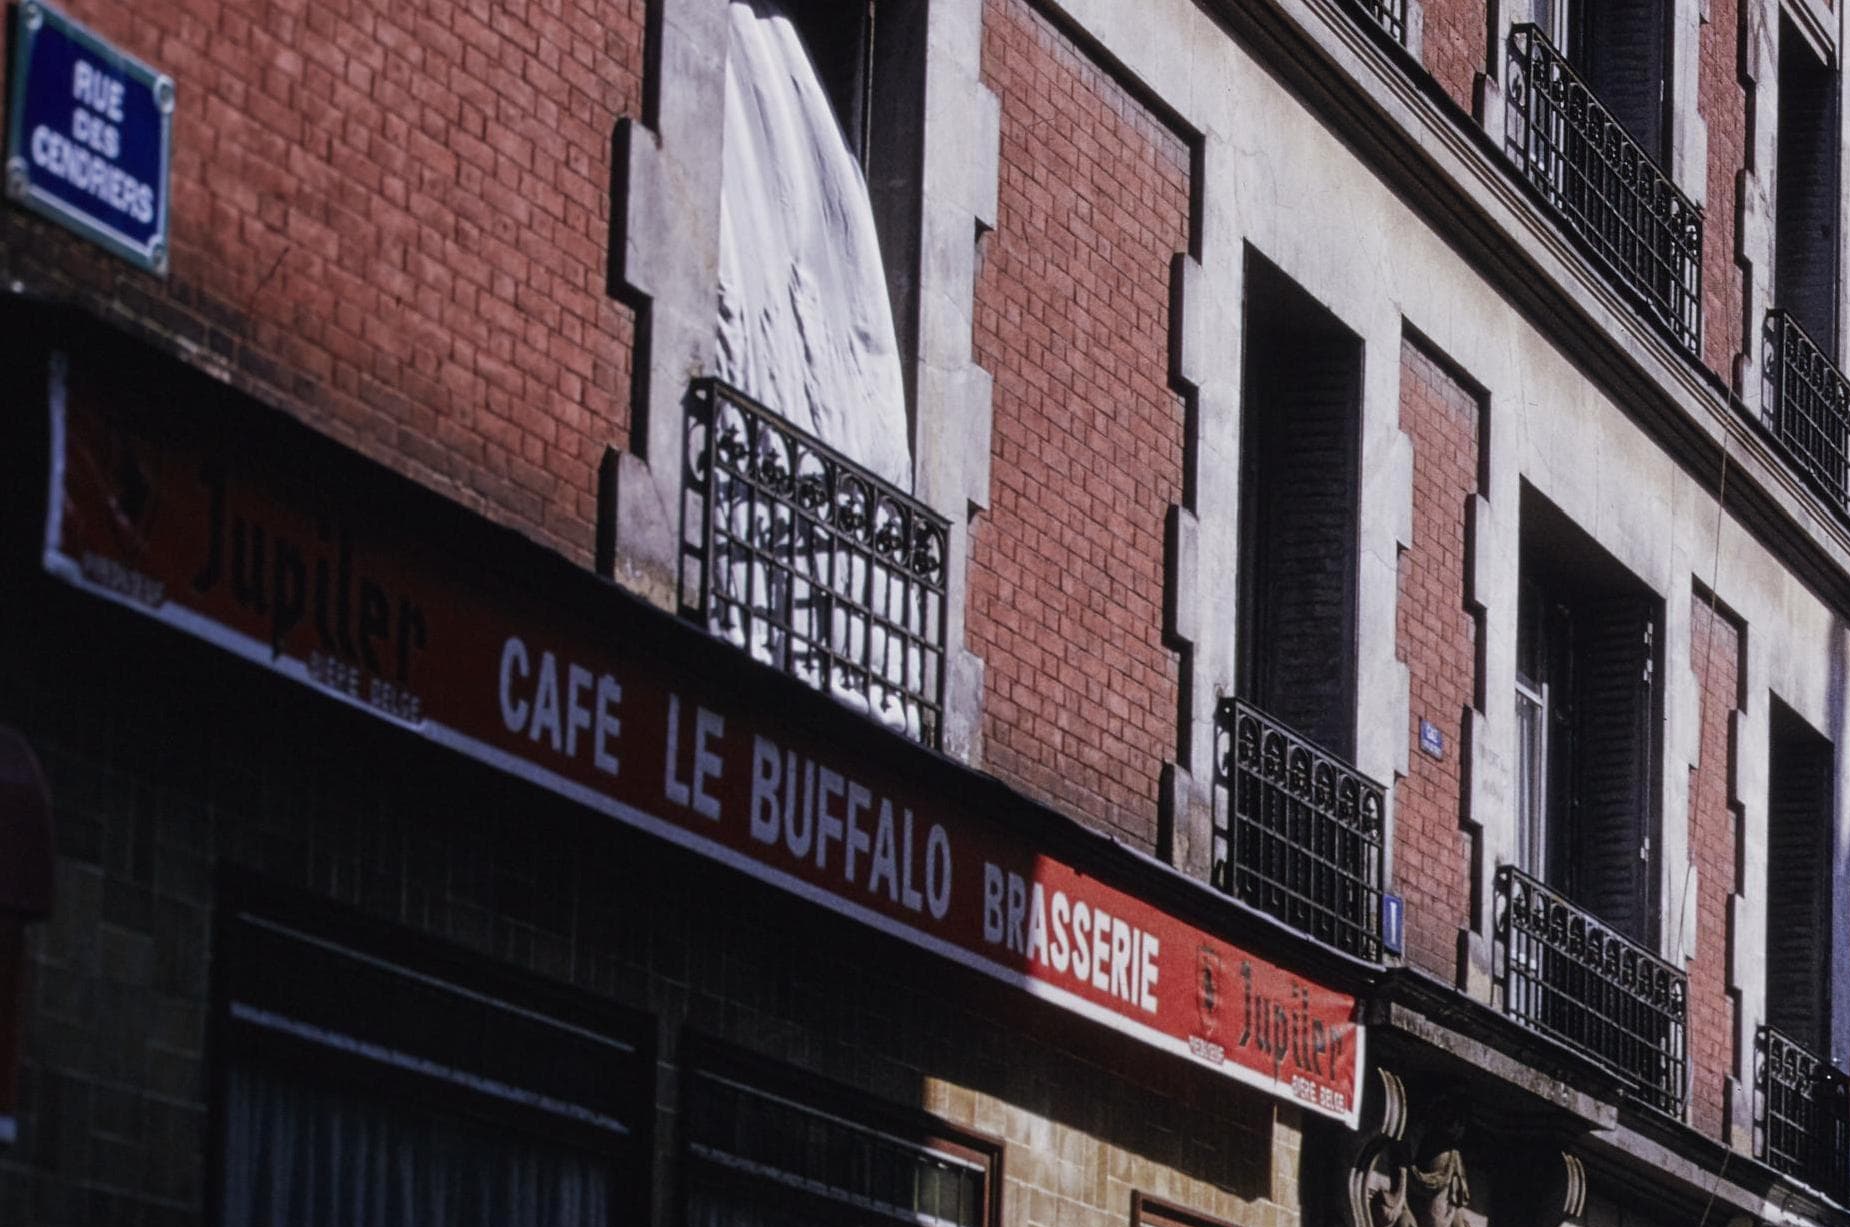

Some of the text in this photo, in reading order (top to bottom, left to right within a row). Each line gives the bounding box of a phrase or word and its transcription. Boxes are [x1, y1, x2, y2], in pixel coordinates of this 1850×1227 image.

[72, 107, 120, 159] DES
[73, 59, 125, 123] RUE
[31, 124, 153, 224] CENDRIERS
[665, 694, 724, 821] LE
[751, 735, 952, 920] BUFFALO
[984, 861, 1160, 1014] BRASSERIE
[1239, 960, 1342, 1086] Jupiler
